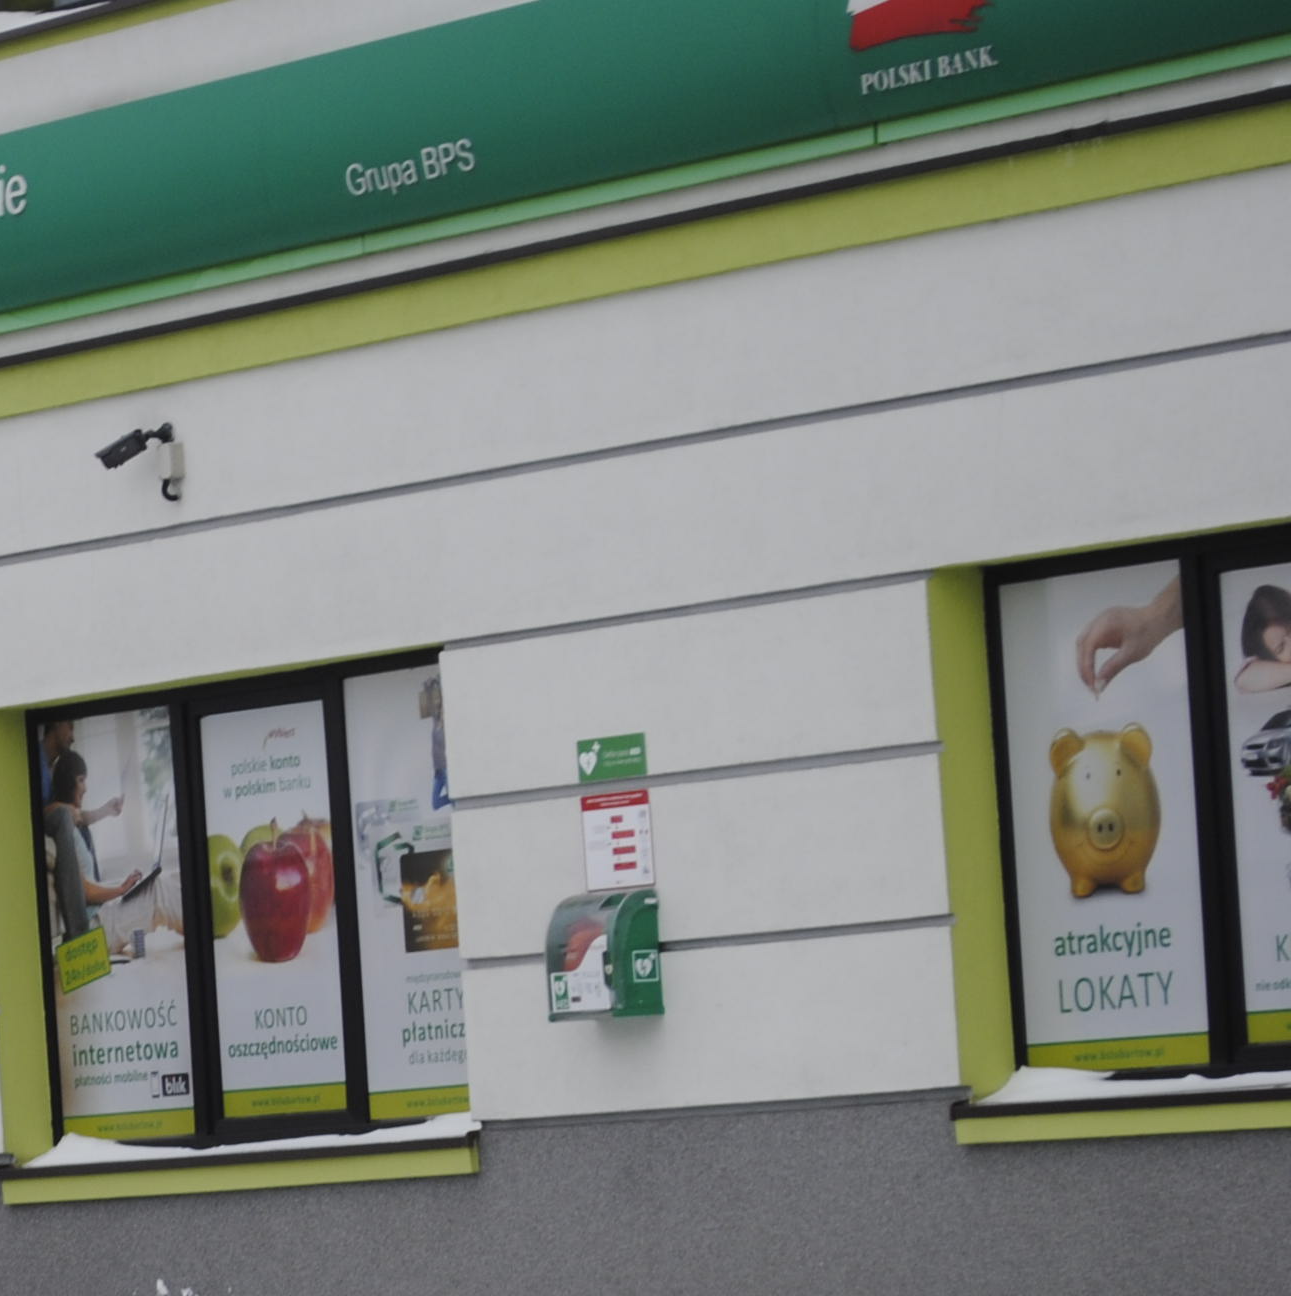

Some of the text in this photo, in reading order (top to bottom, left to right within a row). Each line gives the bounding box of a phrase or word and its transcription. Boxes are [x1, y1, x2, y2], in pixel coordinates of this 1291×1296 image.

[860, 59, 932, 95] POLSKI
[345, 138, 476, 196] Grupa BPS
[269, 754, 301, 770] konto
[234, 779, 277, 801] polskim
[1054, 921, 1172, 958] atrakcyjne
[407, 987, 464, 1015] KARTY
[1058, 970, 1174, 1013] LOKATY
[70, 1000, 178, 1036] BANKOWOŚĆ
[254, 1005, 308, 1030] KONTO
[72, 1040, 179, 1067] internetowa
[227, 1034, 338, 1060] oszczędnościowe
[166, 1076, 187, 1094] blik
